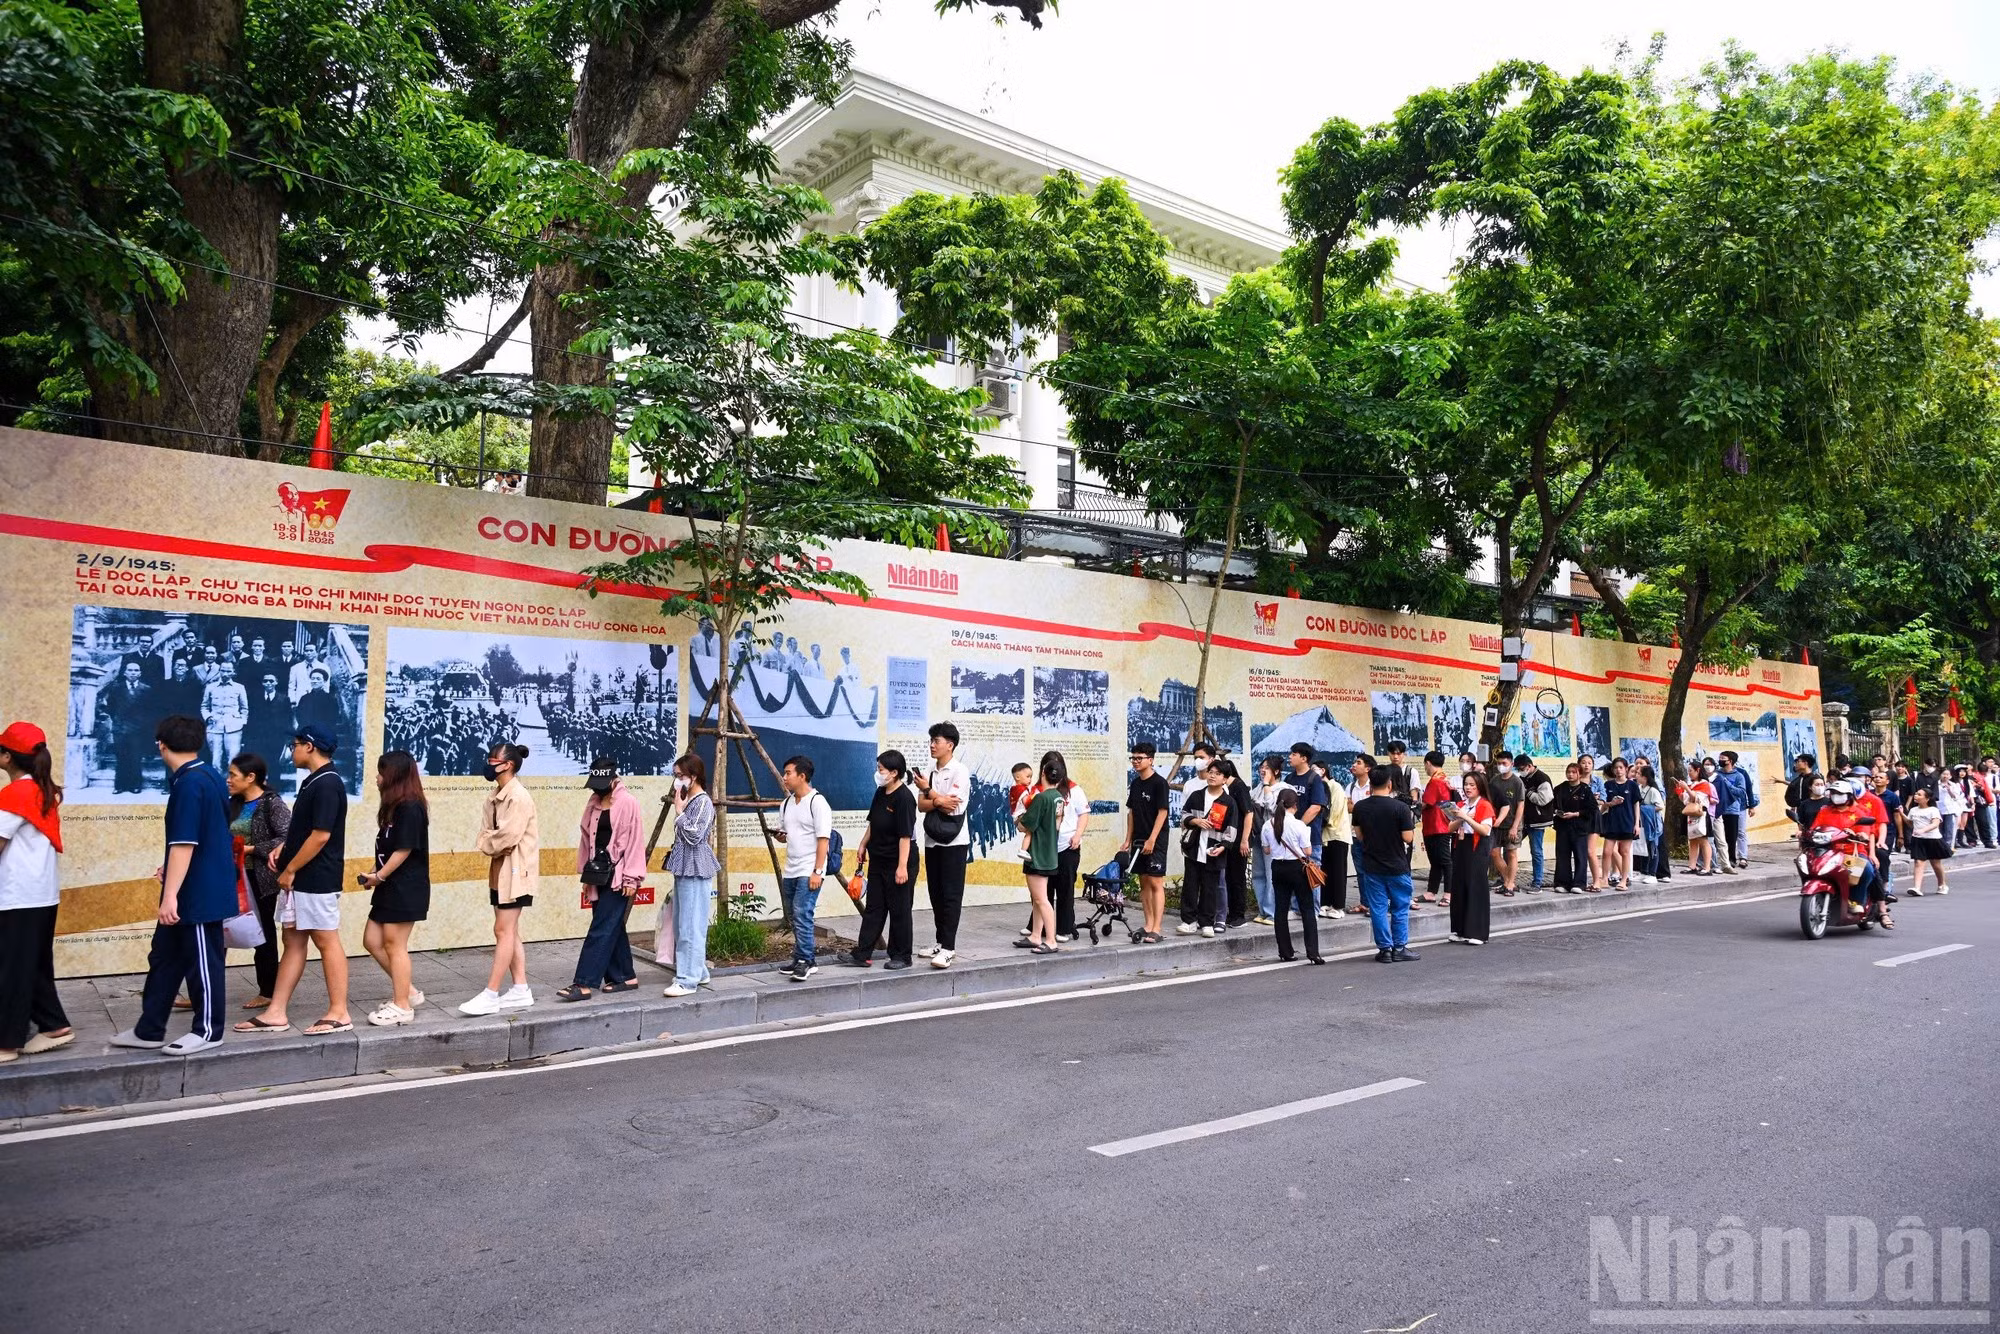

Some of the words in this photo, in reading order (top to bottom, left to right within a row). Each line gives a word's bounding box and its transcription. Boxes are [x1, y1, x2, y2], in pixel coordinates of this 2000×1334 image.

[308, 530, 334, 538] 1945
[478, 516, 556, 546] CON
[76, 553, 176, 572] 2/9/1945:
[888, 563, 927, 587] Nhân
[930, 569, 958, 590] Dân
[350, 591, 388, 602] MINH
[264, 597, 287, 607] BA
[341, 603, 378, 614] KHAI
[383, 605, 418, 617] SINH
[506, 615, 538, 626] NAM
[1306, 615, 1335, 632] CON
[951, 629, 998, 640] 19/8/1945:
